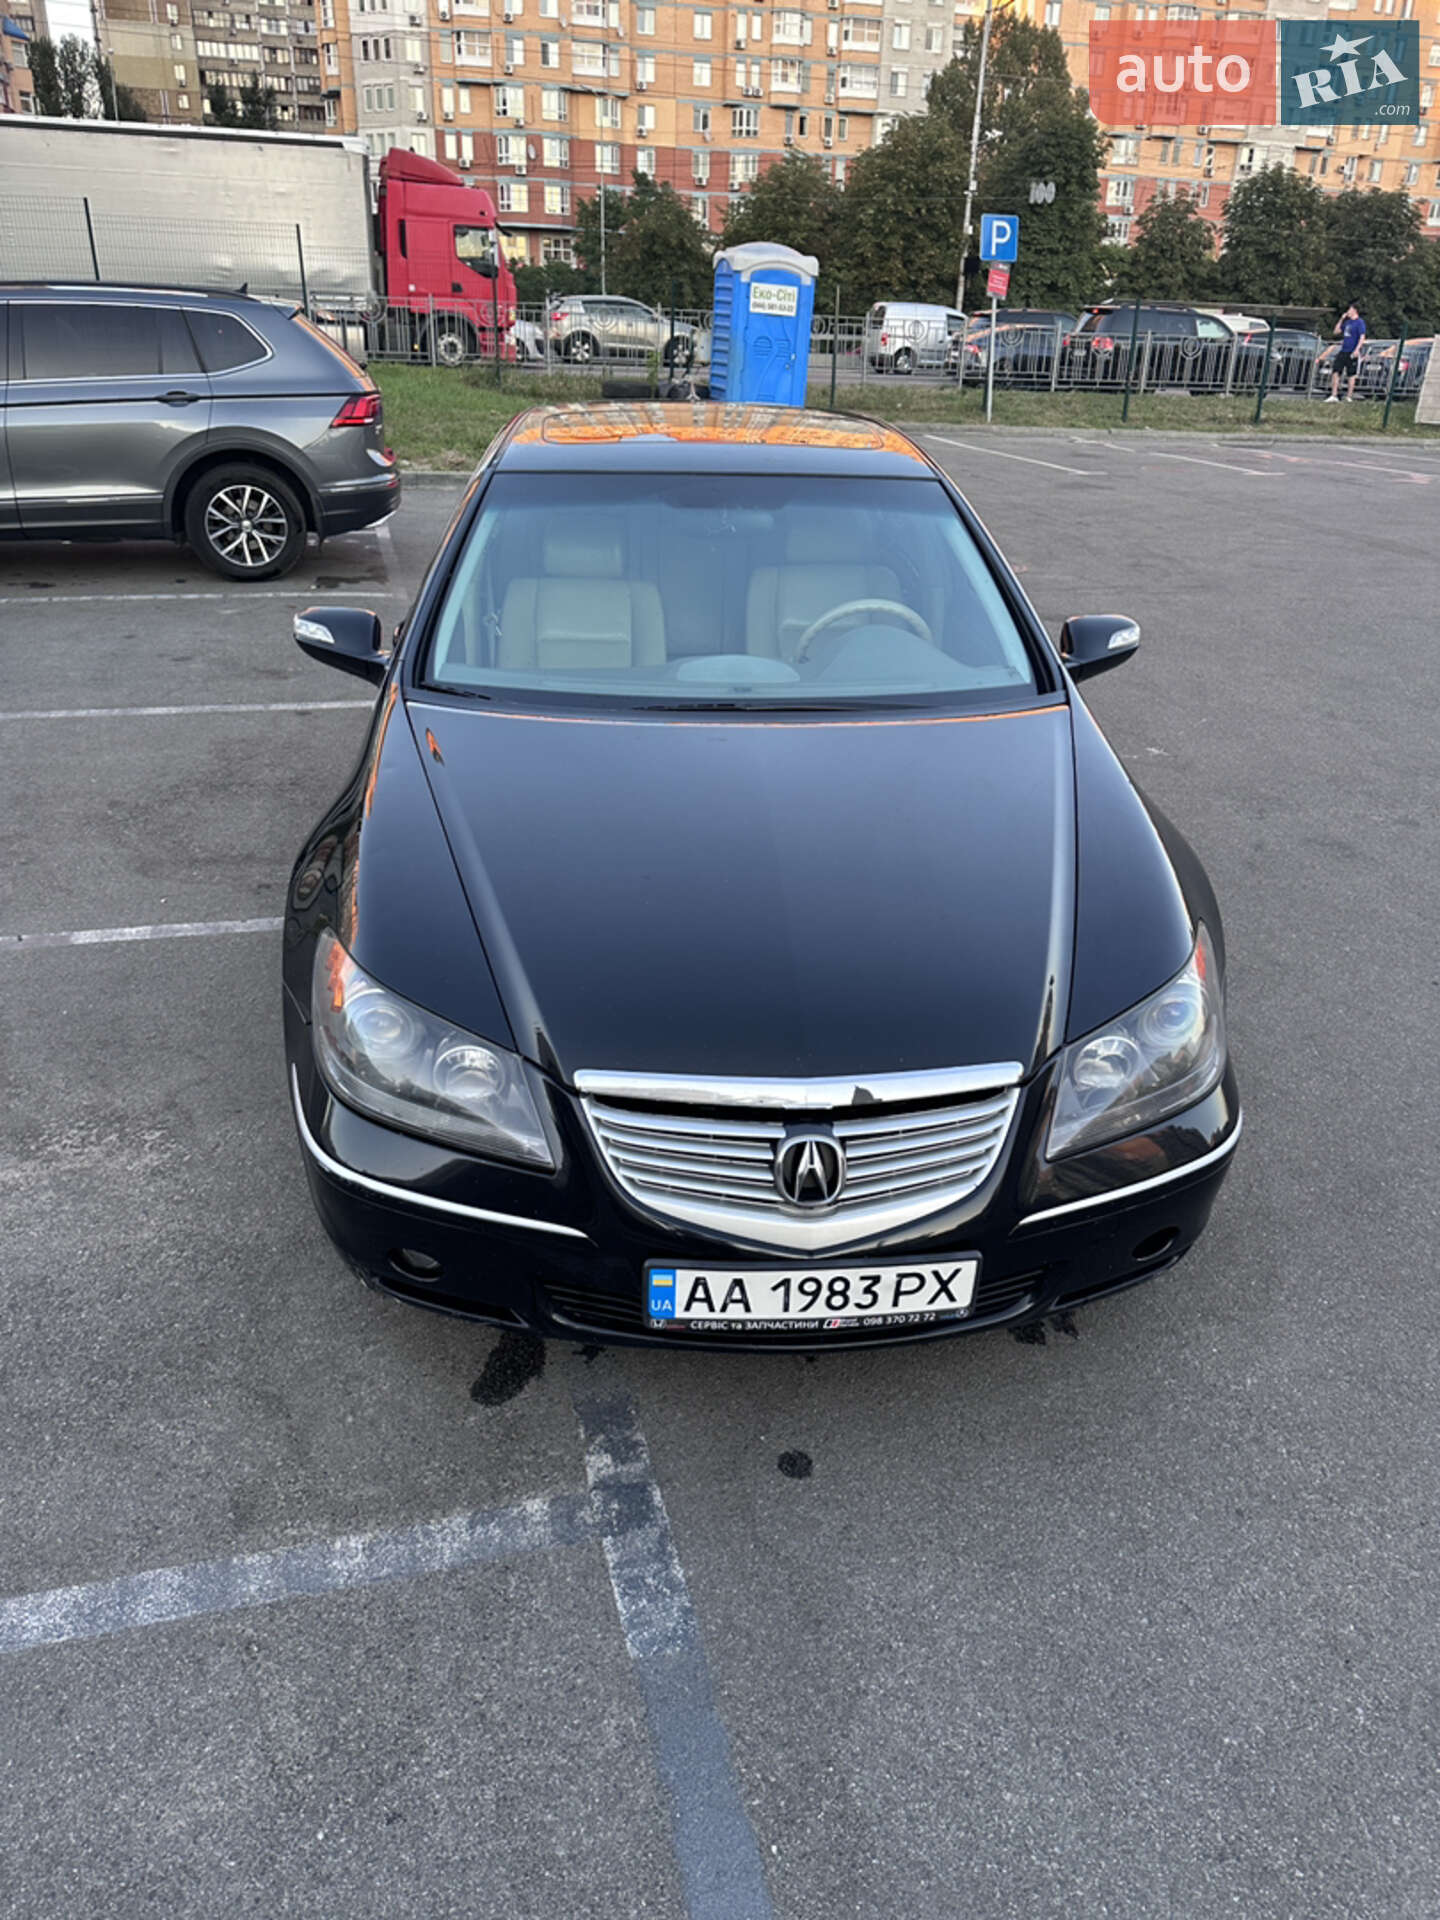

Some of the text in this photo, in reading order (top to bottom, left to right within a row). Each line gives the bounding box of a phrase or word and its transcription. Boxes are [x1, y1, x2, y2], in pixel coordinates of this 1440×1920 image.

[991, 220, 1012, 256] P
[683, 1267, 962, 1313] AA 1983 PX
[651, 1299, 672, 1312] UA
[690, 1320, 729, 1330] СЕРВІС
[745, 1320, 819, 1331] ЗАПЧАСТИНИ
[863, 1317, 882, 1326] 098
[885, 1315, 906, 1325] 370
[908, 1314, 921, 1323] 72
[923, 1312, 936, 1321] 72
